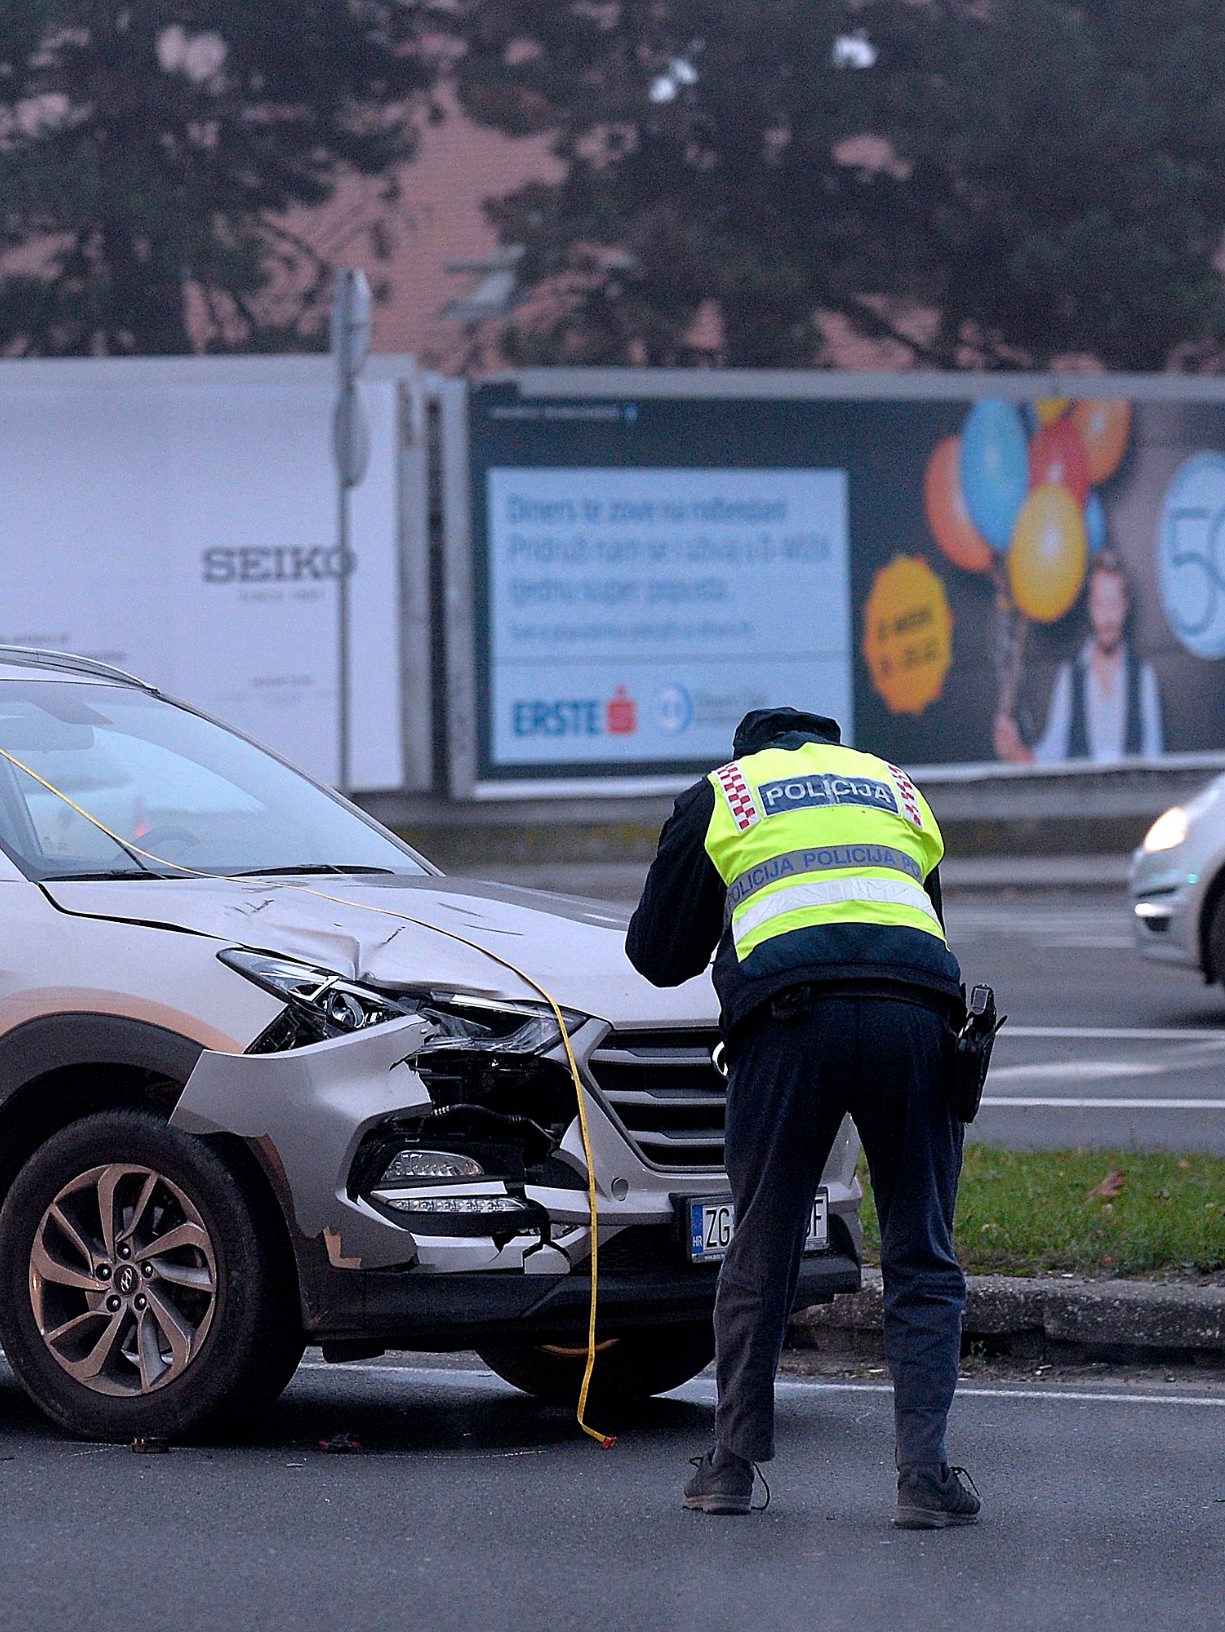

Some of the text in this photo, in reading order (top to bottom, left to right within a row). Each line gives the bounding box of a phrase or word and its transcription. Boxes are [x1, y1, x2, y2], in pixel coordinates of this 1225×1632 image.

[202, 544, 357, 584] SEIKO
[513, 699, 599, 737] ERSTE
[765, 779, 893, 807] POLICIJA
[803, 847, 896, 868] POLICIJA
[692, 1235, 703, 1248] HR
[706, 1207, 730, 1248] ZG
